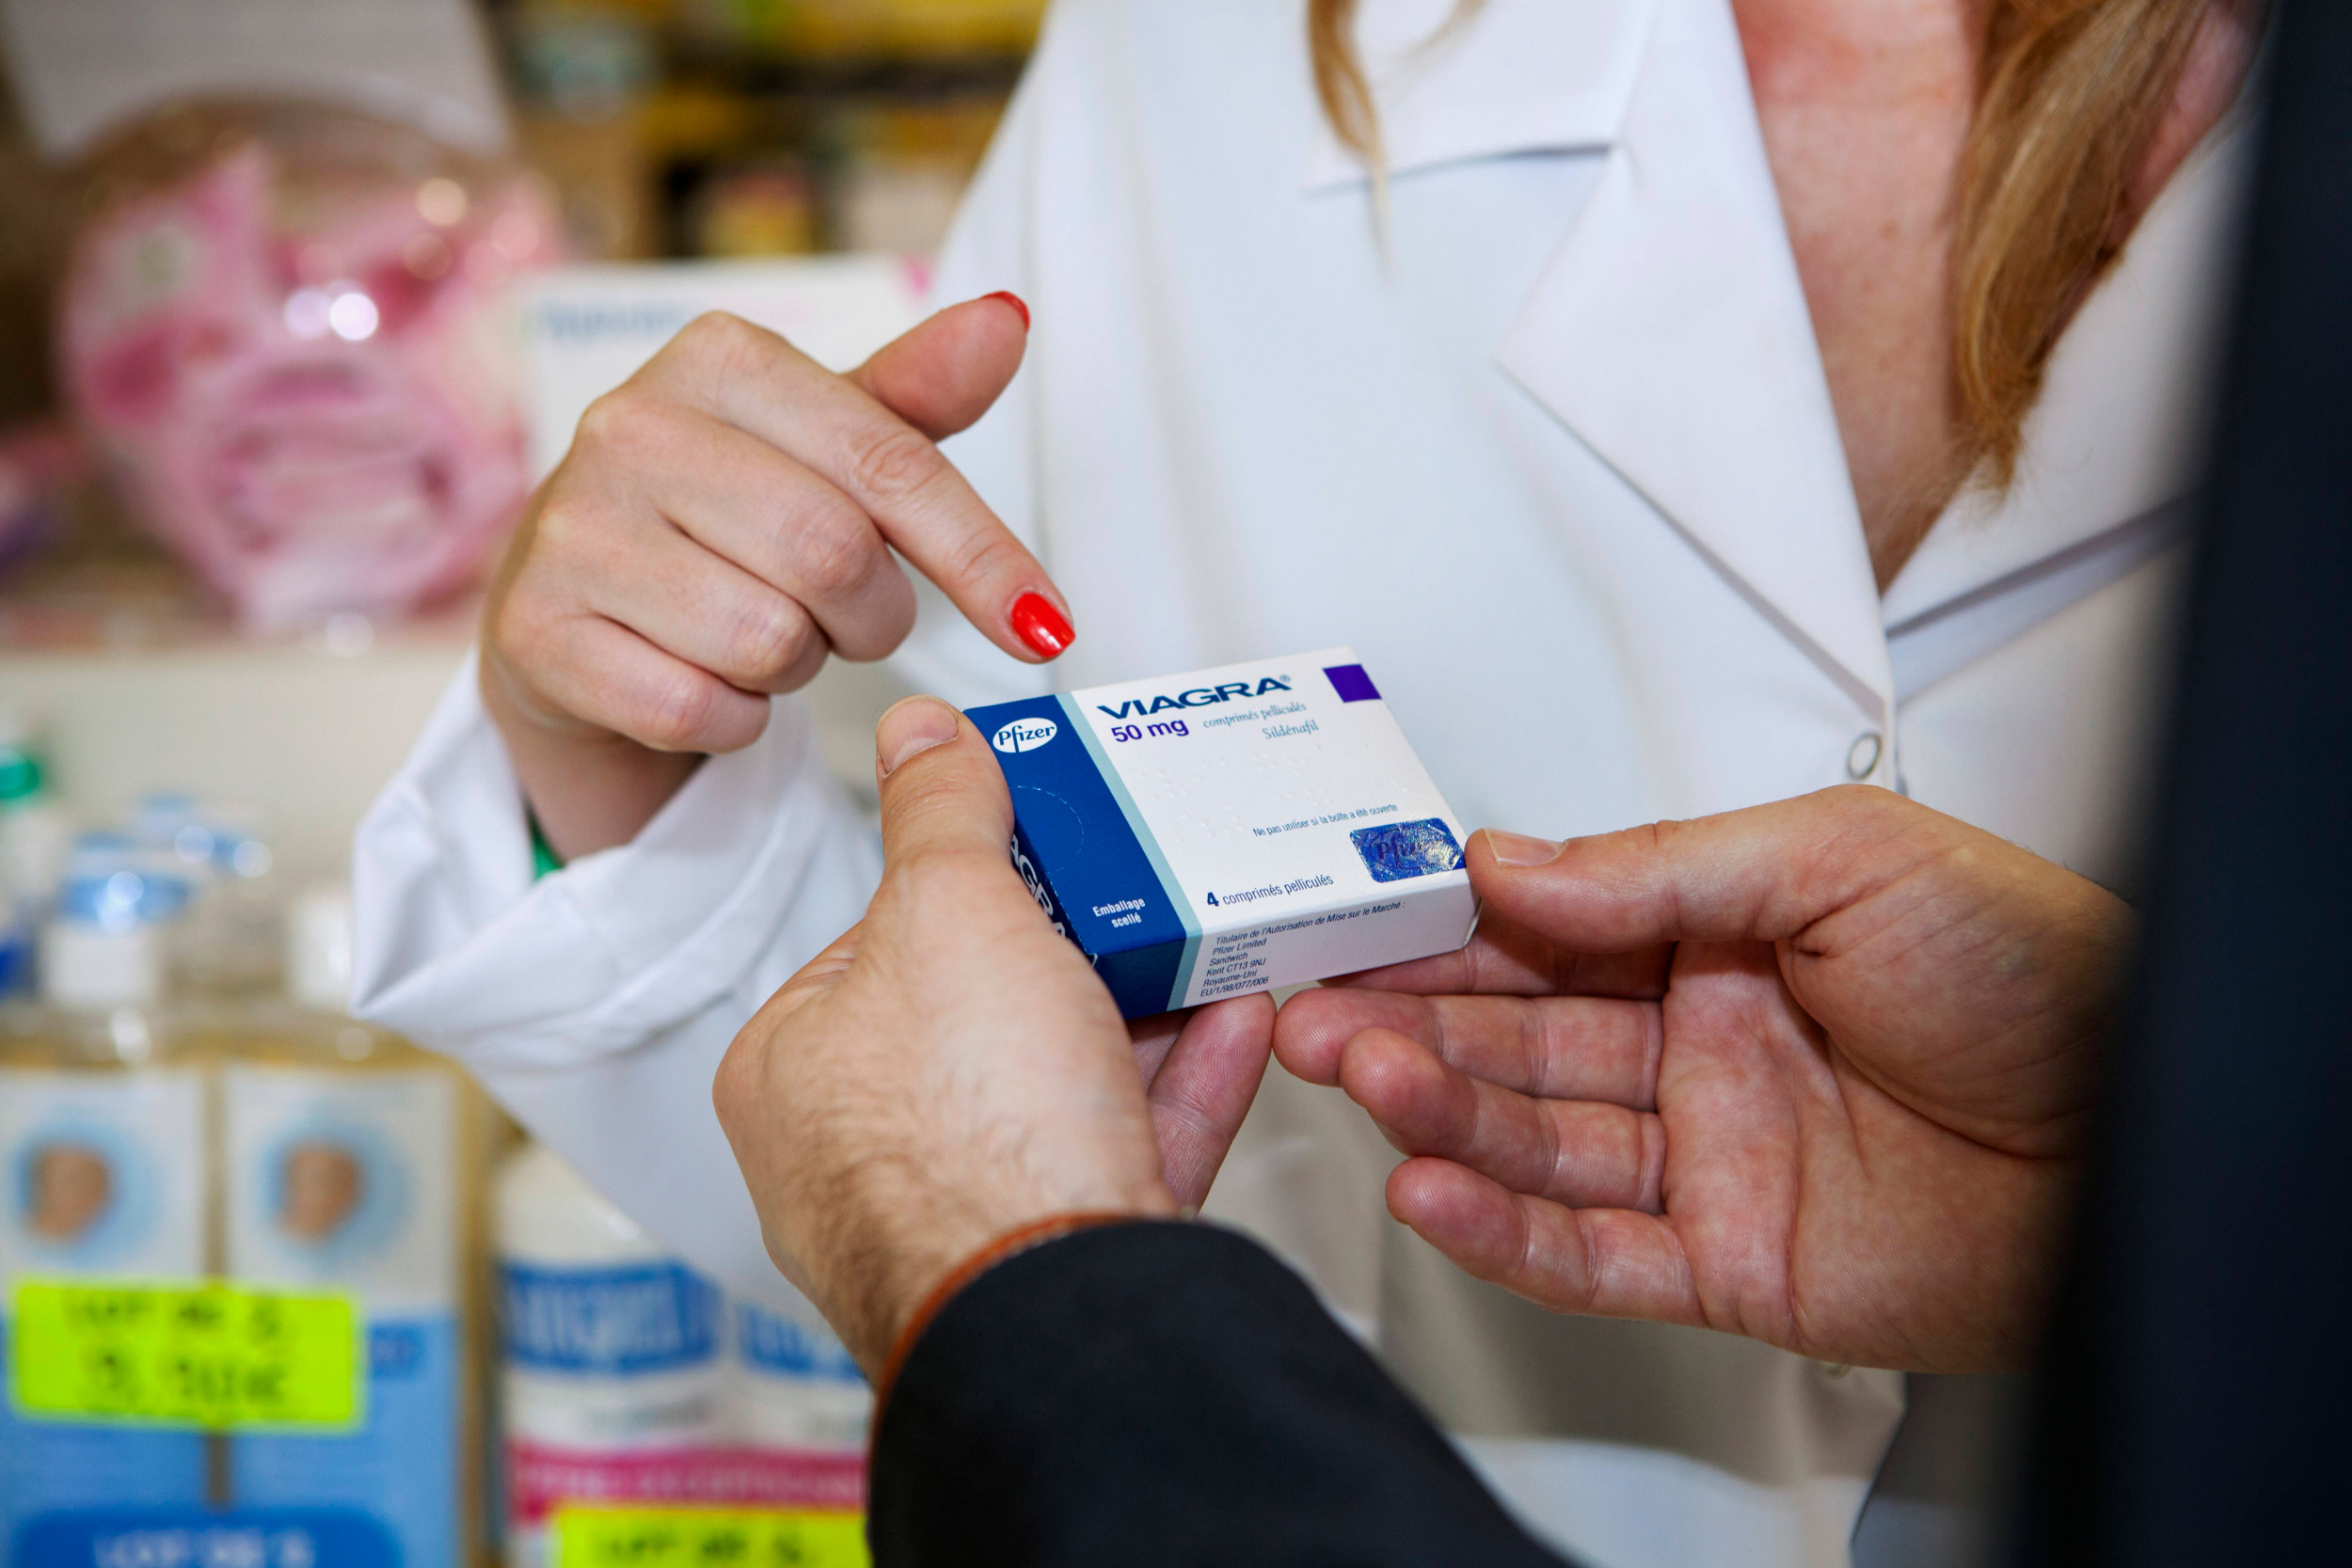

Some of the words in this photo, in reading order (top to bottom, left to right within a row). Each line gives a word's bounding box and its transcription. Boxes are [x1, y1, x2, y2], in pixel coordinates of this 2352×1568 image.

[1203, 711, 1260, 728] comprimés
[1260, 702, 1307, 721] pelliculés
[997, 725, 1055, 752] Pfizer
[1111, 724, 1143, 743] 50
[1147, 720, 1189, 736] mg
[1262, 719, 1319, 740] Sildénafil
[1252, 827, 1266, 837] Ne
[1267, 825, 1282, 836] pas
[1283, 819, 1310, 832] utiliser
[1311, 817, 1319, 826] si
[1319, 815, 1328, 825] la
[1328, 812, 1349, 823] boîte
[1356, 808, 1369, 817] été
[1369, 803, 1398, 816] ouverte
[1206, 892, 1219, 907] 4
[1222, 884, 1283, 905] comprimés
[1283, 874, 1334, 895] pelliculés
[1092, 898, 1146, 917] Emballage
[1111, 911, 1142, 927] scellé
[1216, 932, 1248, 945] Titulaire
[1250, 929, 1261, 939] de
[1314, 916, 1325, 925] de
[1327, 912, 1346, 923] Mise
[1347, 910, 1361, 919] sur
[1371, 901, 1401, 913] Marché
[1213, 945, 1236, 956] Pfizer
[1236, 938, 1267, 951] Limited
[1206, 967, 1224, 977] Kent
[1226, 961, 1248, 973] CT13
[1249, 958, 1267, 968] 9NJ
[1209, 952, 1248, 967] Sandwich
[1200, 976, 1270, 997] EU/1/98/077/006
[1202, 970, 1258, 988] Royaume-Uni
